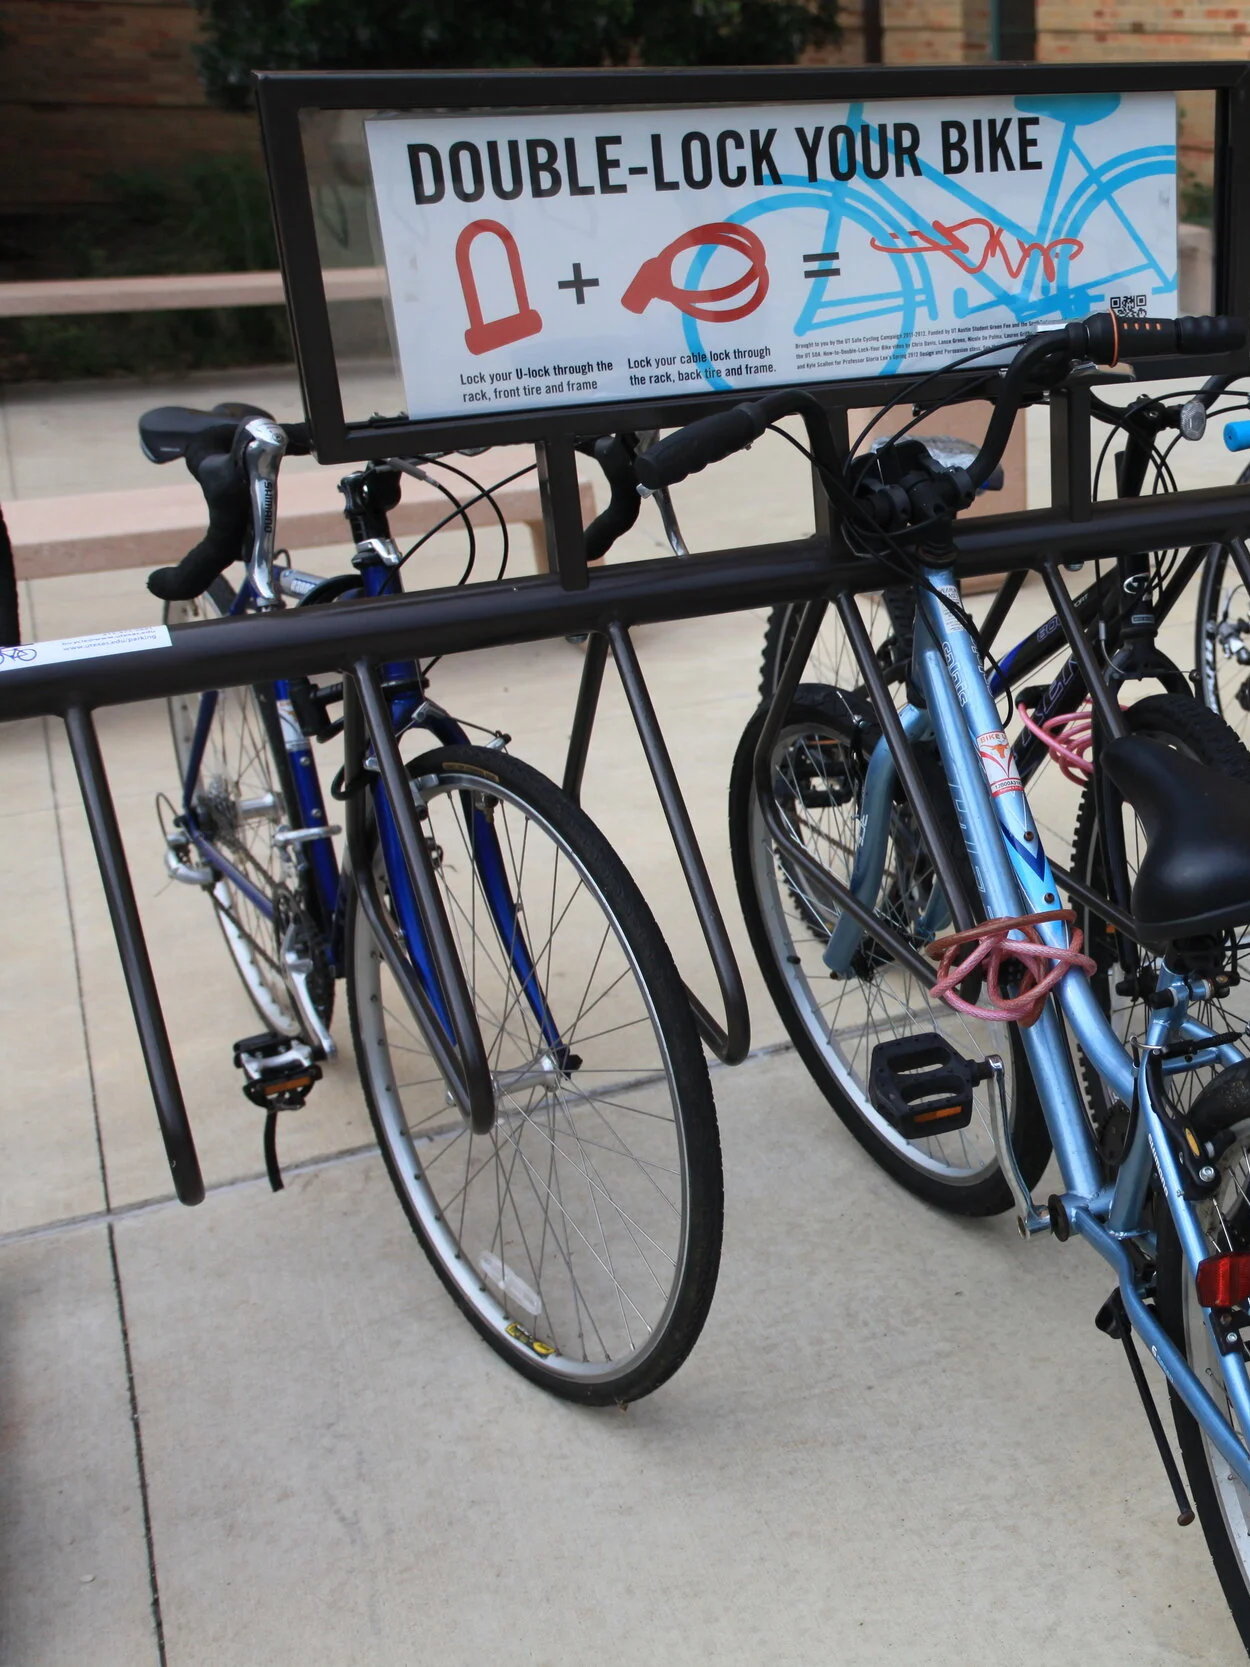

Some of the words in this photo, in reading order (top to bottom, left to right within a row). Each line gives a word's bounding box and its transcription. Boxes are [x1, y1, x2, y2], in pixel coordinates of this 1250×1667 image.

[407, 128, 783, 205] DOUBLE-LOCK
[795, 122, 923, 183] YOUR
[941, 117, 1043, 175] BIKE
[881, 333, 902, 341] Campaign
[628, 357, 652, 369] Lock
[654, 355, 677, 369] your
[679, 351, 707, 364] cable
[709, 349, 730, 362] lock
[733, 346, 771, 361] through
[843, 357, 865, 365] Professor
[460, 372, 486, 385] Lock
[489, 370, 513, 385] your
[516, 364, 550, 380] U-lock
[553, 360, 594, 379] through
[596, 360, 613, 372] the
[629, 374, 646, 386] the
[648, 371, 675, 385] rack,
[678, 368, 702, 381] back
[705, 366, 722, 378] tire
[725, 364, 743, 377] and
[745, 362, 777, 376] frame.
[463, 388, 491, 403] rack,
[493, 385, 521, 399] front
[523, 383, 542, 396] tire
[545, 381, 564, 394] and
[566, 379, 598, 392] frame
[263, 481, 273, 534] SHIMANO
[980, 733, 1001, 743] BIKE
